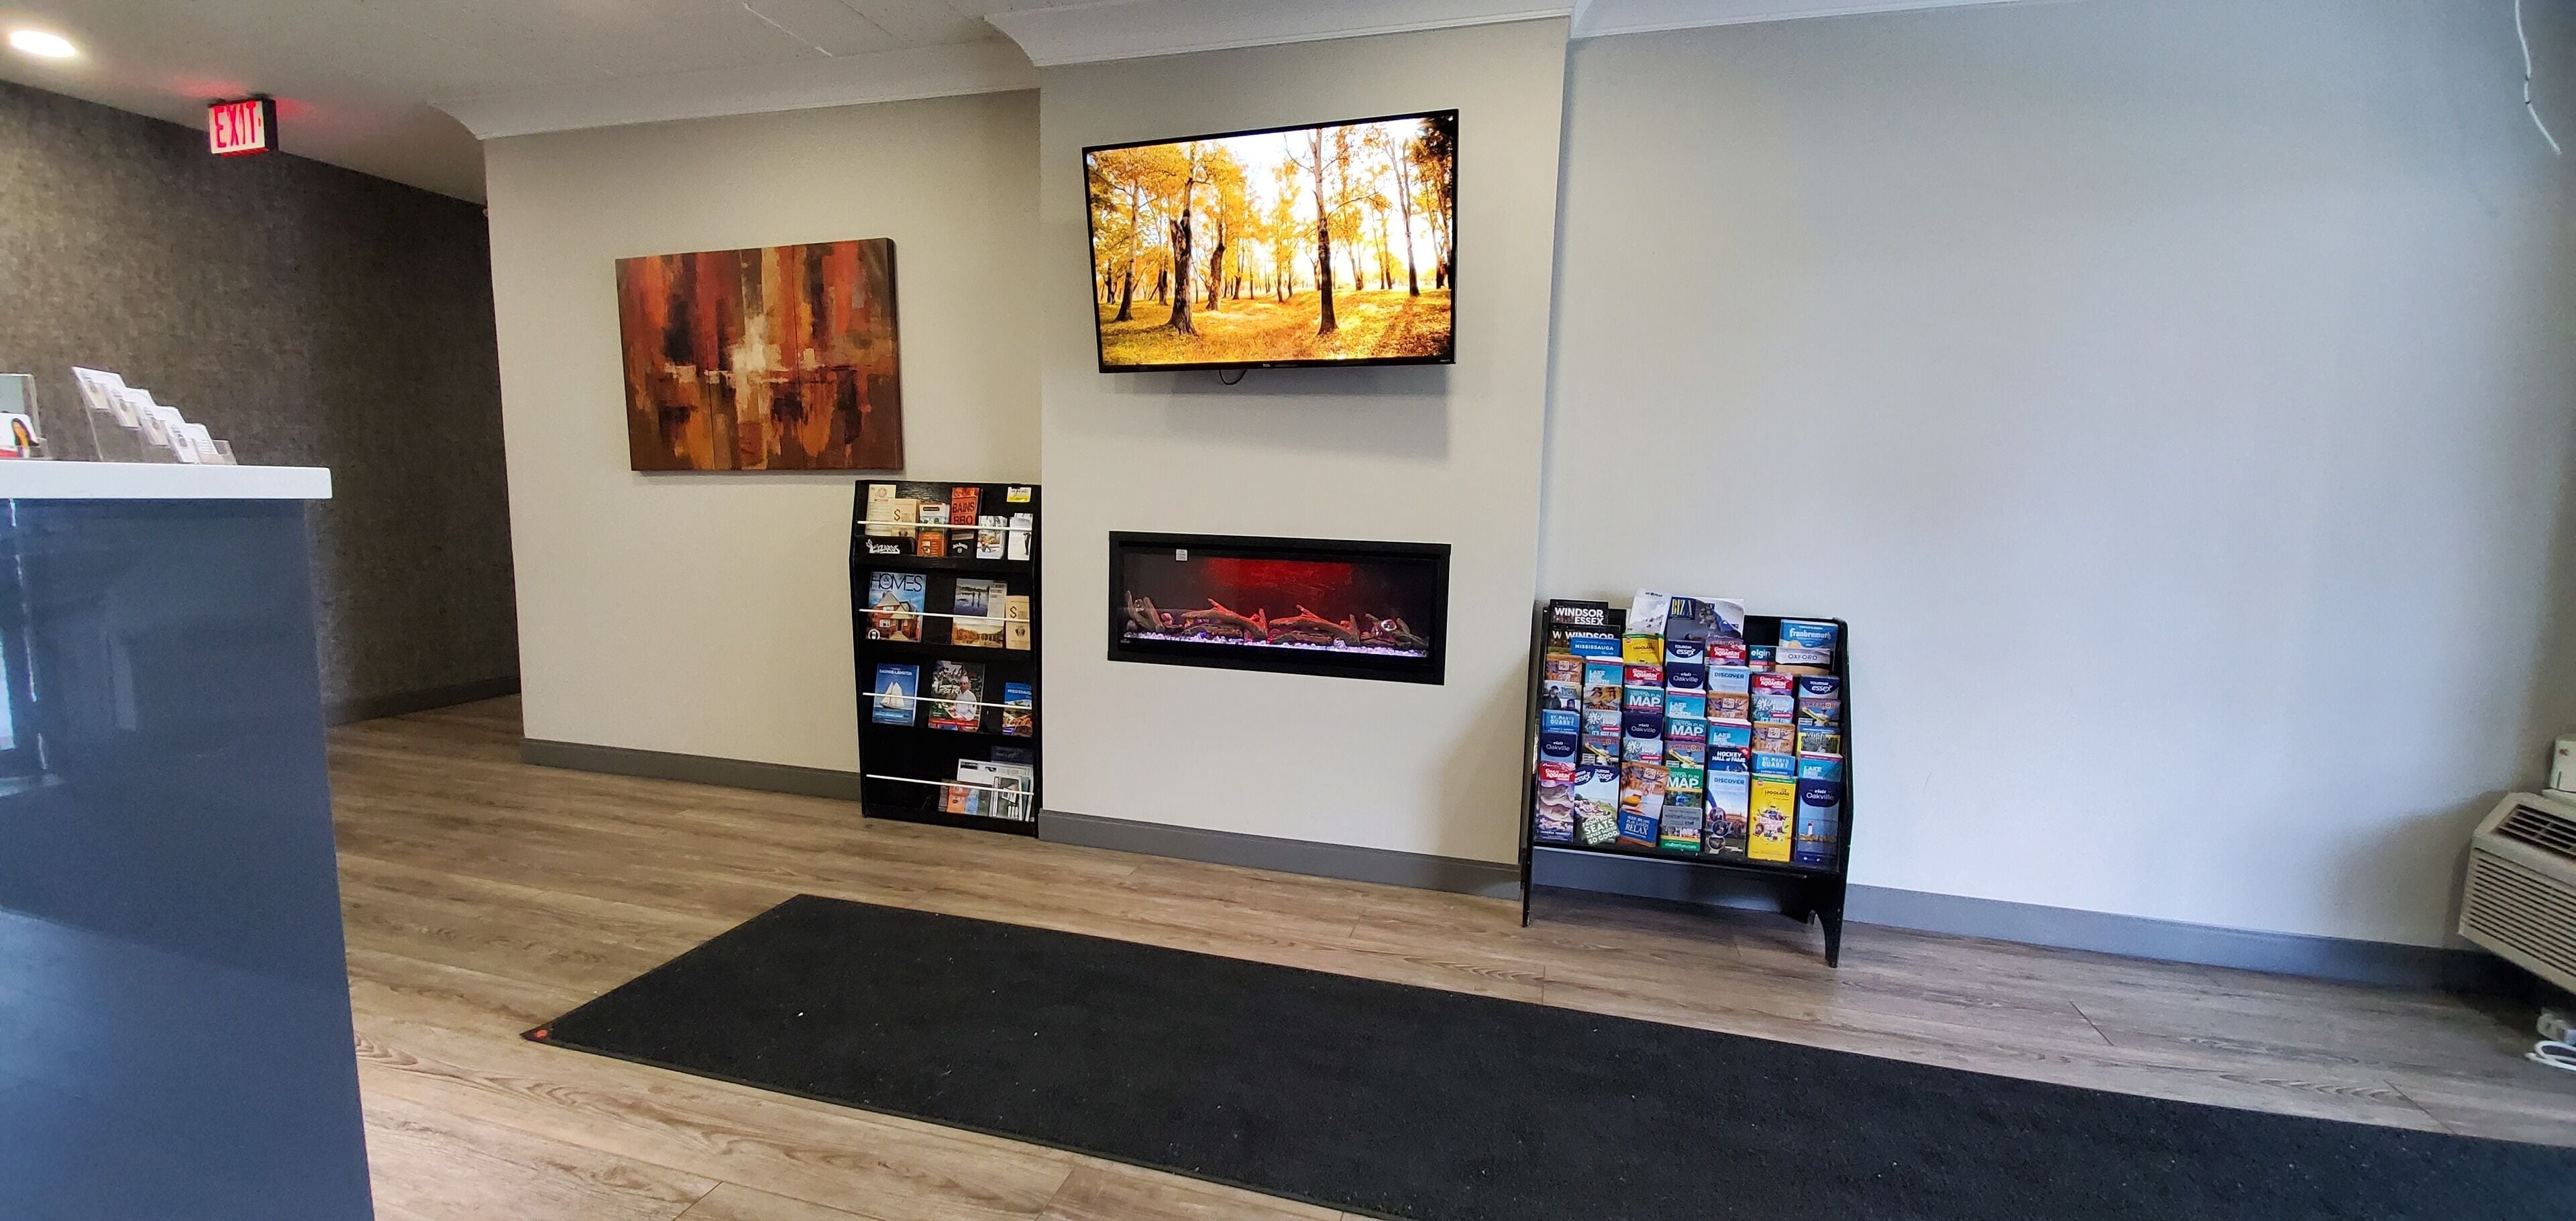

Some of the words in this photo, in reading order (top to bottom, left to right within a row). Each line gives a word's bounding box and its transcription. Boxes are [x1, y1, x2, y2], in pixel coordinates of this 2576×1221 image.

[213, 101, 256, 148] EXIT
[953, 502, 975, 513] BAINS
[870, 573, 923, 592] HOMES
[1554, 606, 1604, 618] WINDSOR
[1671, 598, 1685, 615] BIZ
[1685, 600, 1693, 616] X
[1574, 617, 1604, 625] ESSEX
[1676, 648, 1696, 657] essex
[1751, 649, 1770, 659] elgin
[1811, 684, 1833, 692] essex
[1629, 695, 1662, 707] MAP
[1671, 725, 1704, 737] MAP
[1667, 776, 1699, 788] MAP
[1806, 792, 1835, 801] Oakville
[1584, 818, 1615, 835] SEATS
[1587, 831, 1600, 839] NEVER
[1601, 826, 1617, 834] TASTED
[1625, 823, 1648, 835] RELAX
